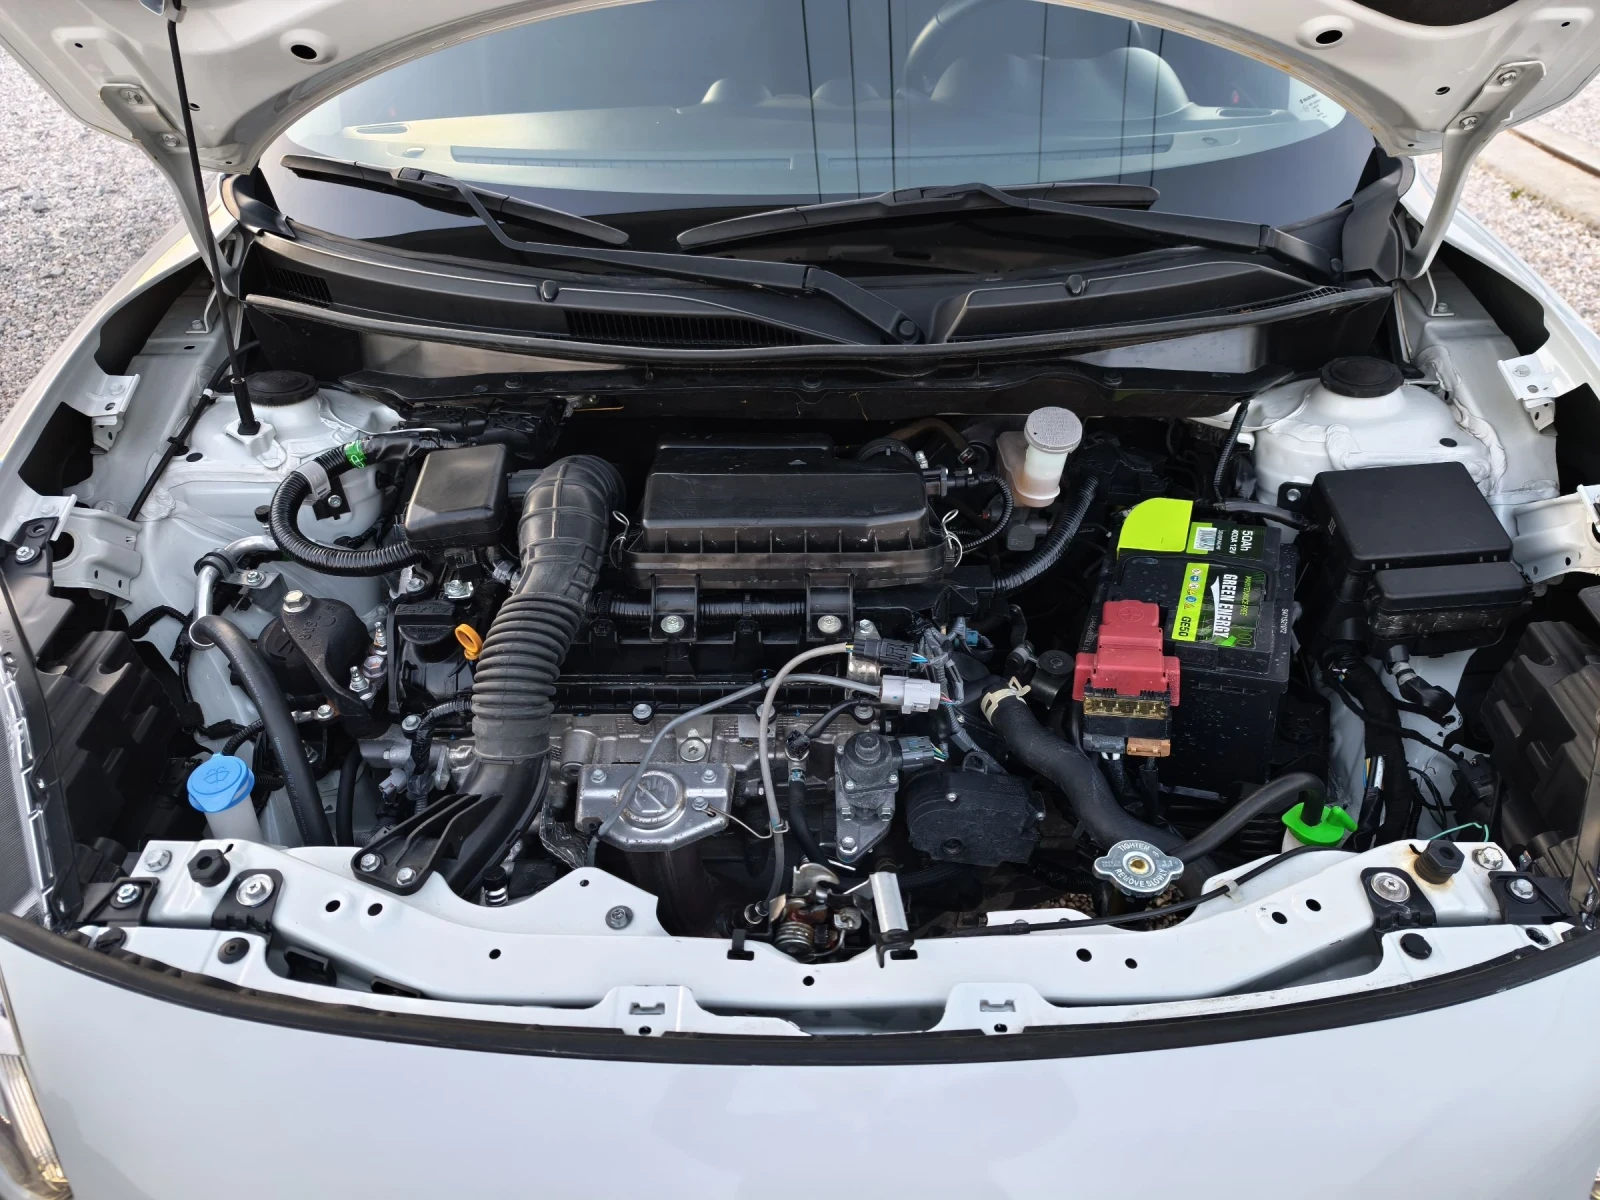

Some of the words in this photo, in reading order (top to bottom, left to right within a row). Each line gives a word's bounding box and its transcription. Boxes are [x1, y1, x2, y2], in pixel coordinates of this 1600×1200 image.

[1231, 529, 1239, 544] 400A
[1240, 530, 1253, 551] 50Ah
[1229, 543, 1237, 555] 12V
[1220, 574, 1238, 602] GREEN
[1241, 576, 1252, 606] MAINTENANCE
[1178, 616, 1192, 637] GE50
[1215, 603, 1233, 638] ENERGY
[1117, 842, 1150, 852] TIGHTEN
[1114, 868, 1145, 888] REMOVE
[1145, 868, 1168, 888] SLOWLY
